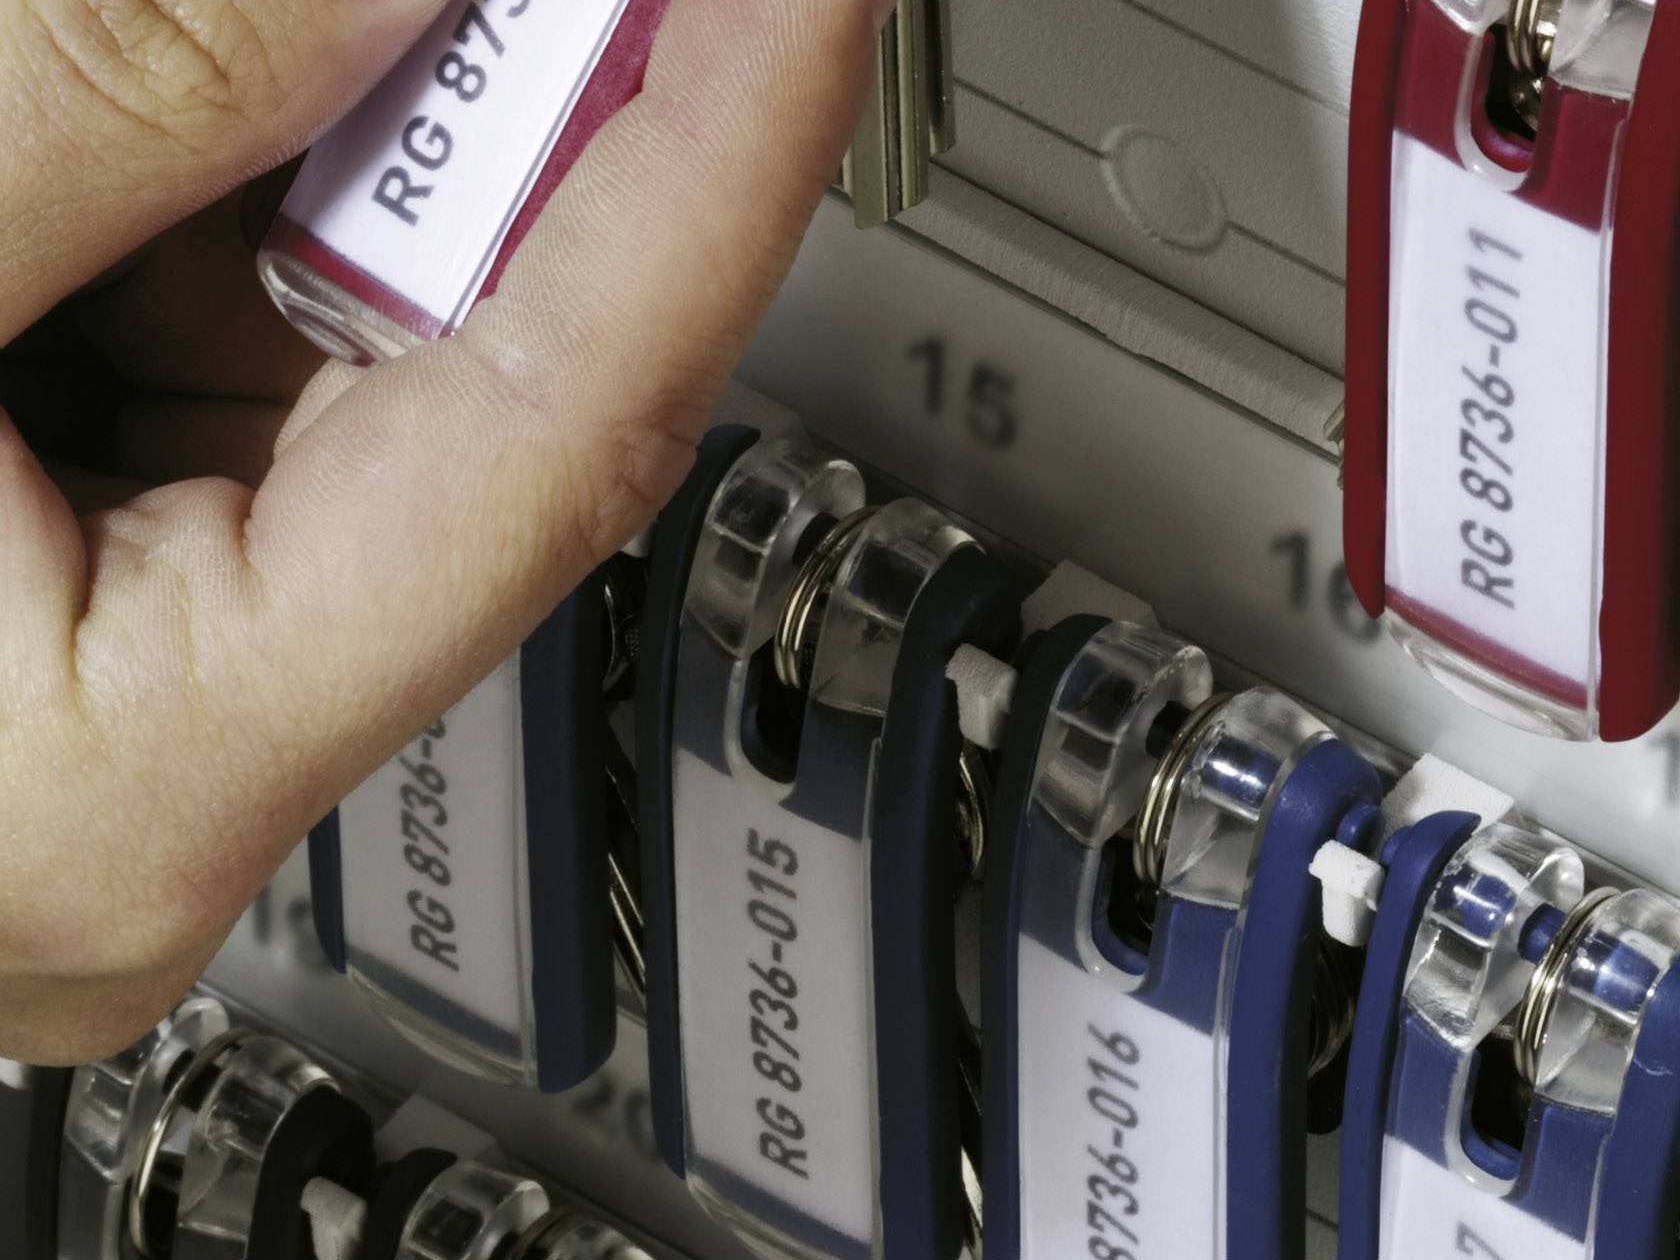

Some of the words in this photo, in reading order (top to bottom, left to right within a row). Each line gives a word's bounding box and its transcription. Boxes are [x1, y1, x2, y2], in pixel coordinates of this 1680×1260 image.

[372, 113, 456, 226] RG
[905, 335, 1016, 447] 15
[1459, 228, 1522, 514] 8736-011
[1459, 519, 1516, 609] RG
[398, 718, 452, 887] 8736-
[405, 889, 460, 973] RG
[745, 826, 804, 1093] 8736-015
[755, 1096, 810, 1181] RG
